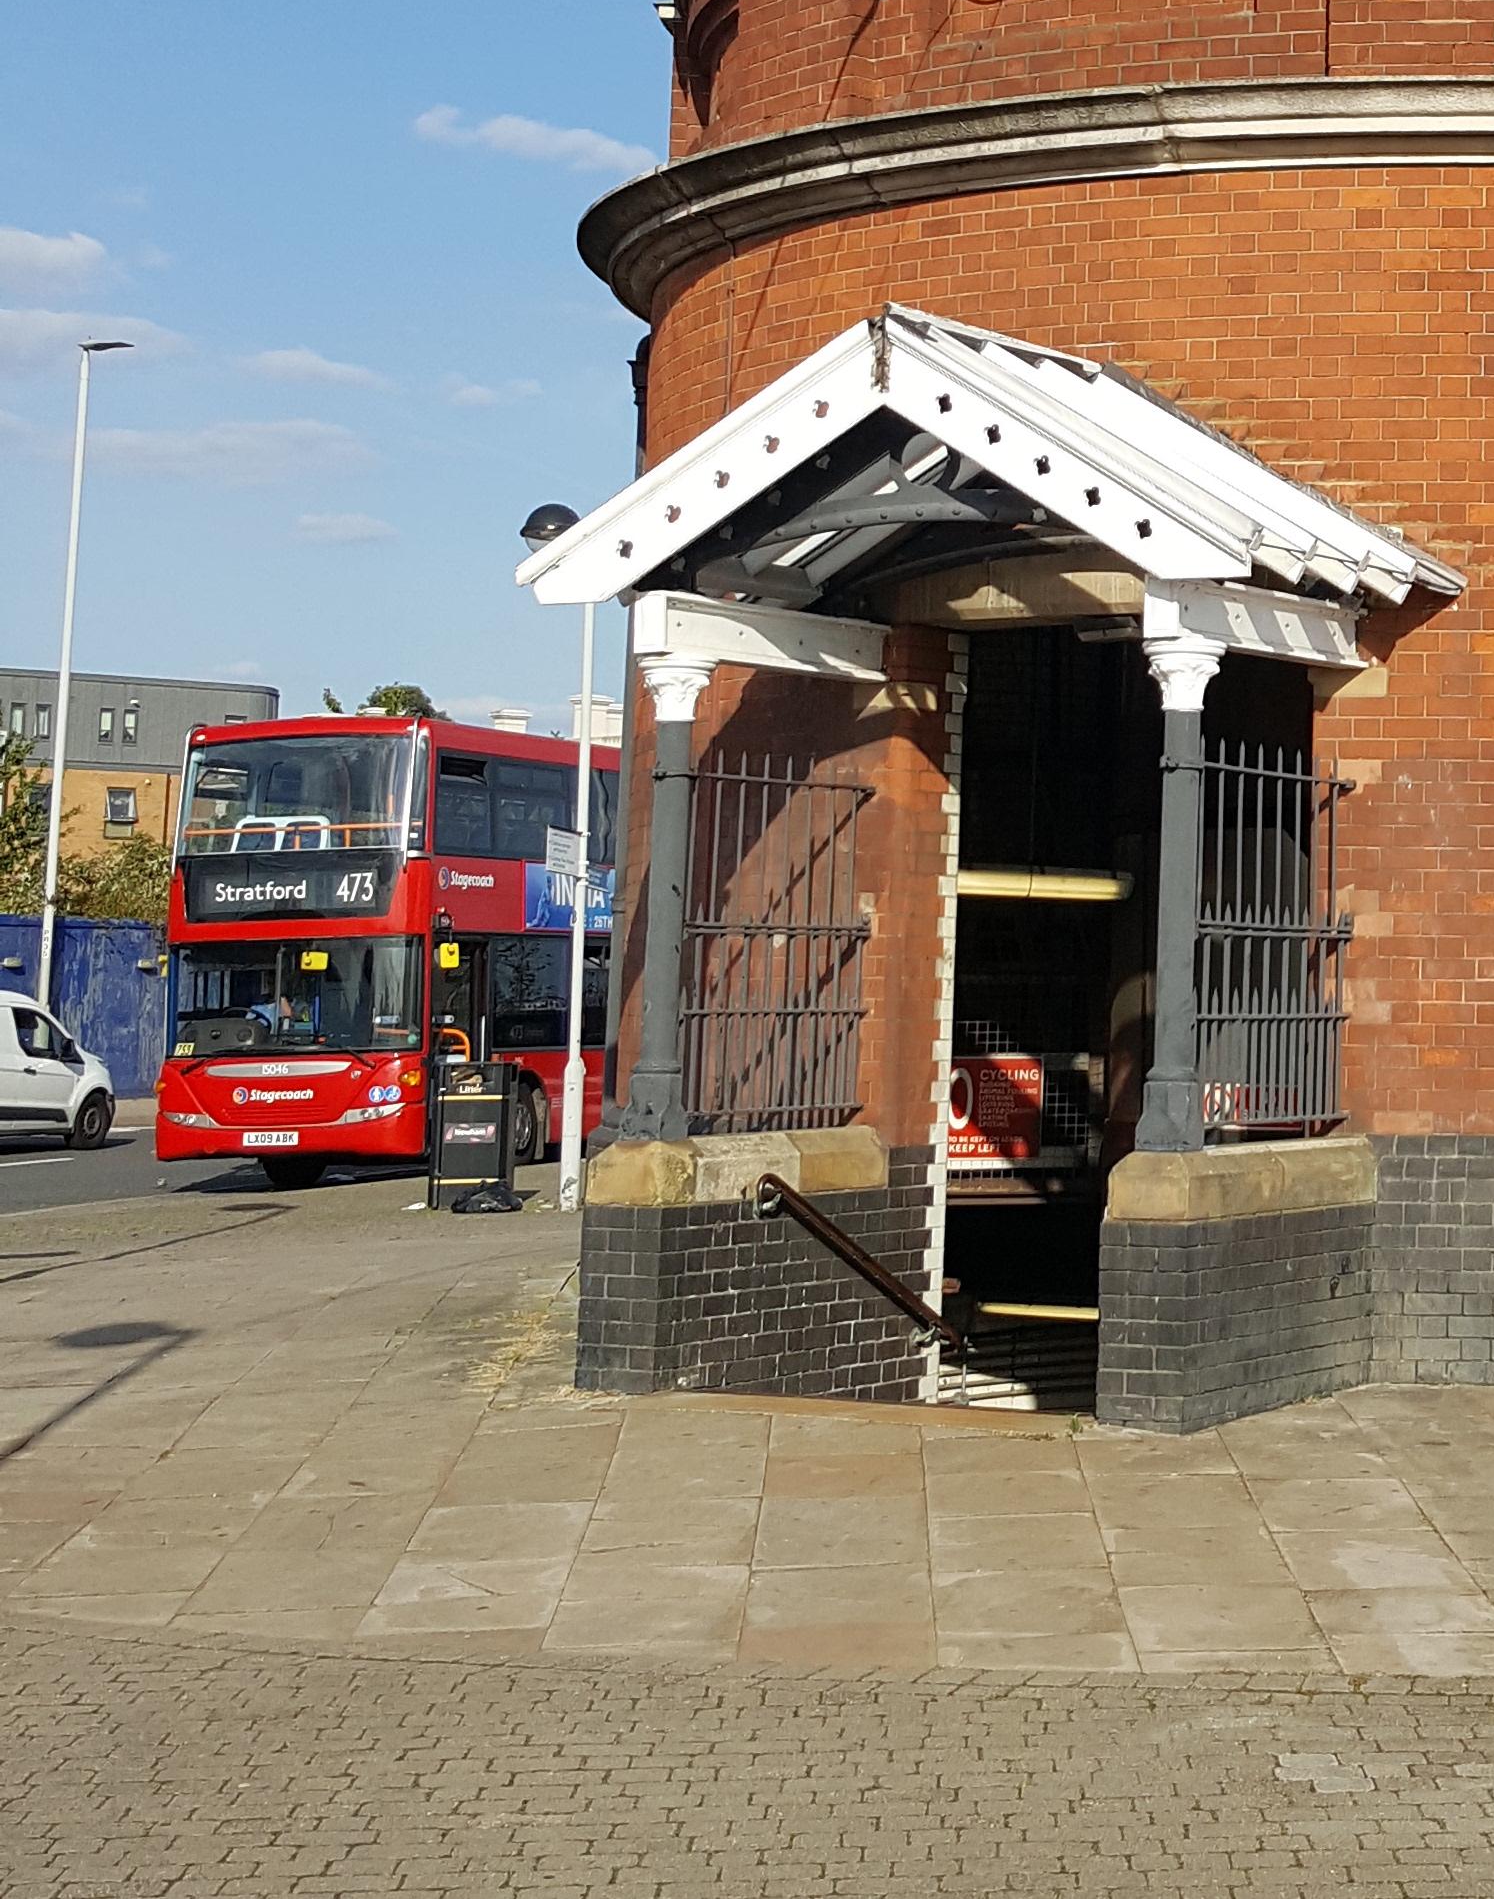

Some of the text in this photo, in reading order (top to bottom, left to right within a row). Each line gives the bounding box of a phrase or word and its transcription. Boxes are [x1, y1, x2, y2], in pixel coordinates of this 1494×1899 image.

[336, 872, 374, 902] 473
[450, 870, 495, 889] Stagecoach
[215, 879, 307, 902] Stratford
[555, 874, 605, 908] INIA
[980, 1068, 1040, 1081] CYCLING
[249, 1088, 314, 1104] Stagecoach
[247, 1133, 295, 1144] LX09 ABK
[949, 1143, 1000, 1153] KEEP LEFT
